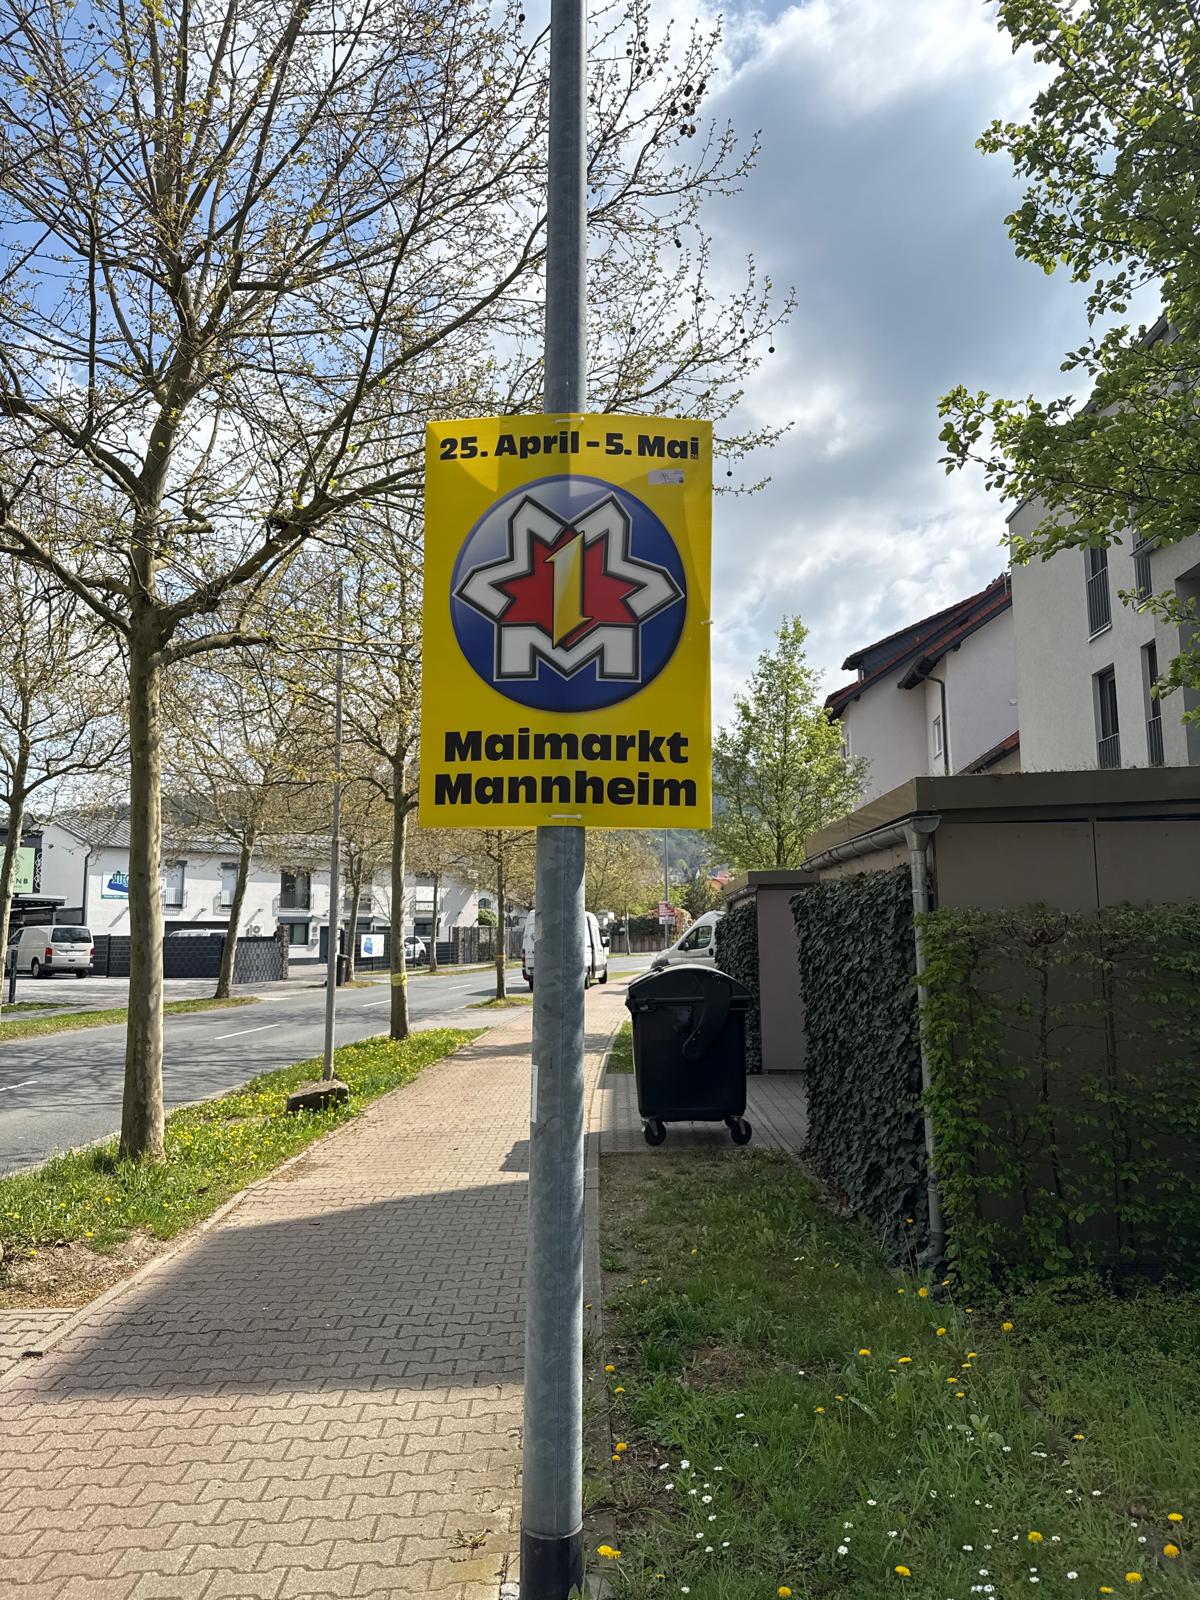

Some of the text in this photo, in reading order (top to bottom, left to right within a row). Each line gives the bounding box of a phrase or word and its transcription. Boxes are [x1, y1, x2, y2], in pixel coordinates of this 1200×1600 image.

[438, 437, 488, 461] 25.
[494, 431, 580, 459] April
[605, 432, 633, 456] 5.
[637, 434, 700, 460] Mai
[444, 727, 689, 764] Maimarkt
[434, 770, 697, 807] Mannheim
